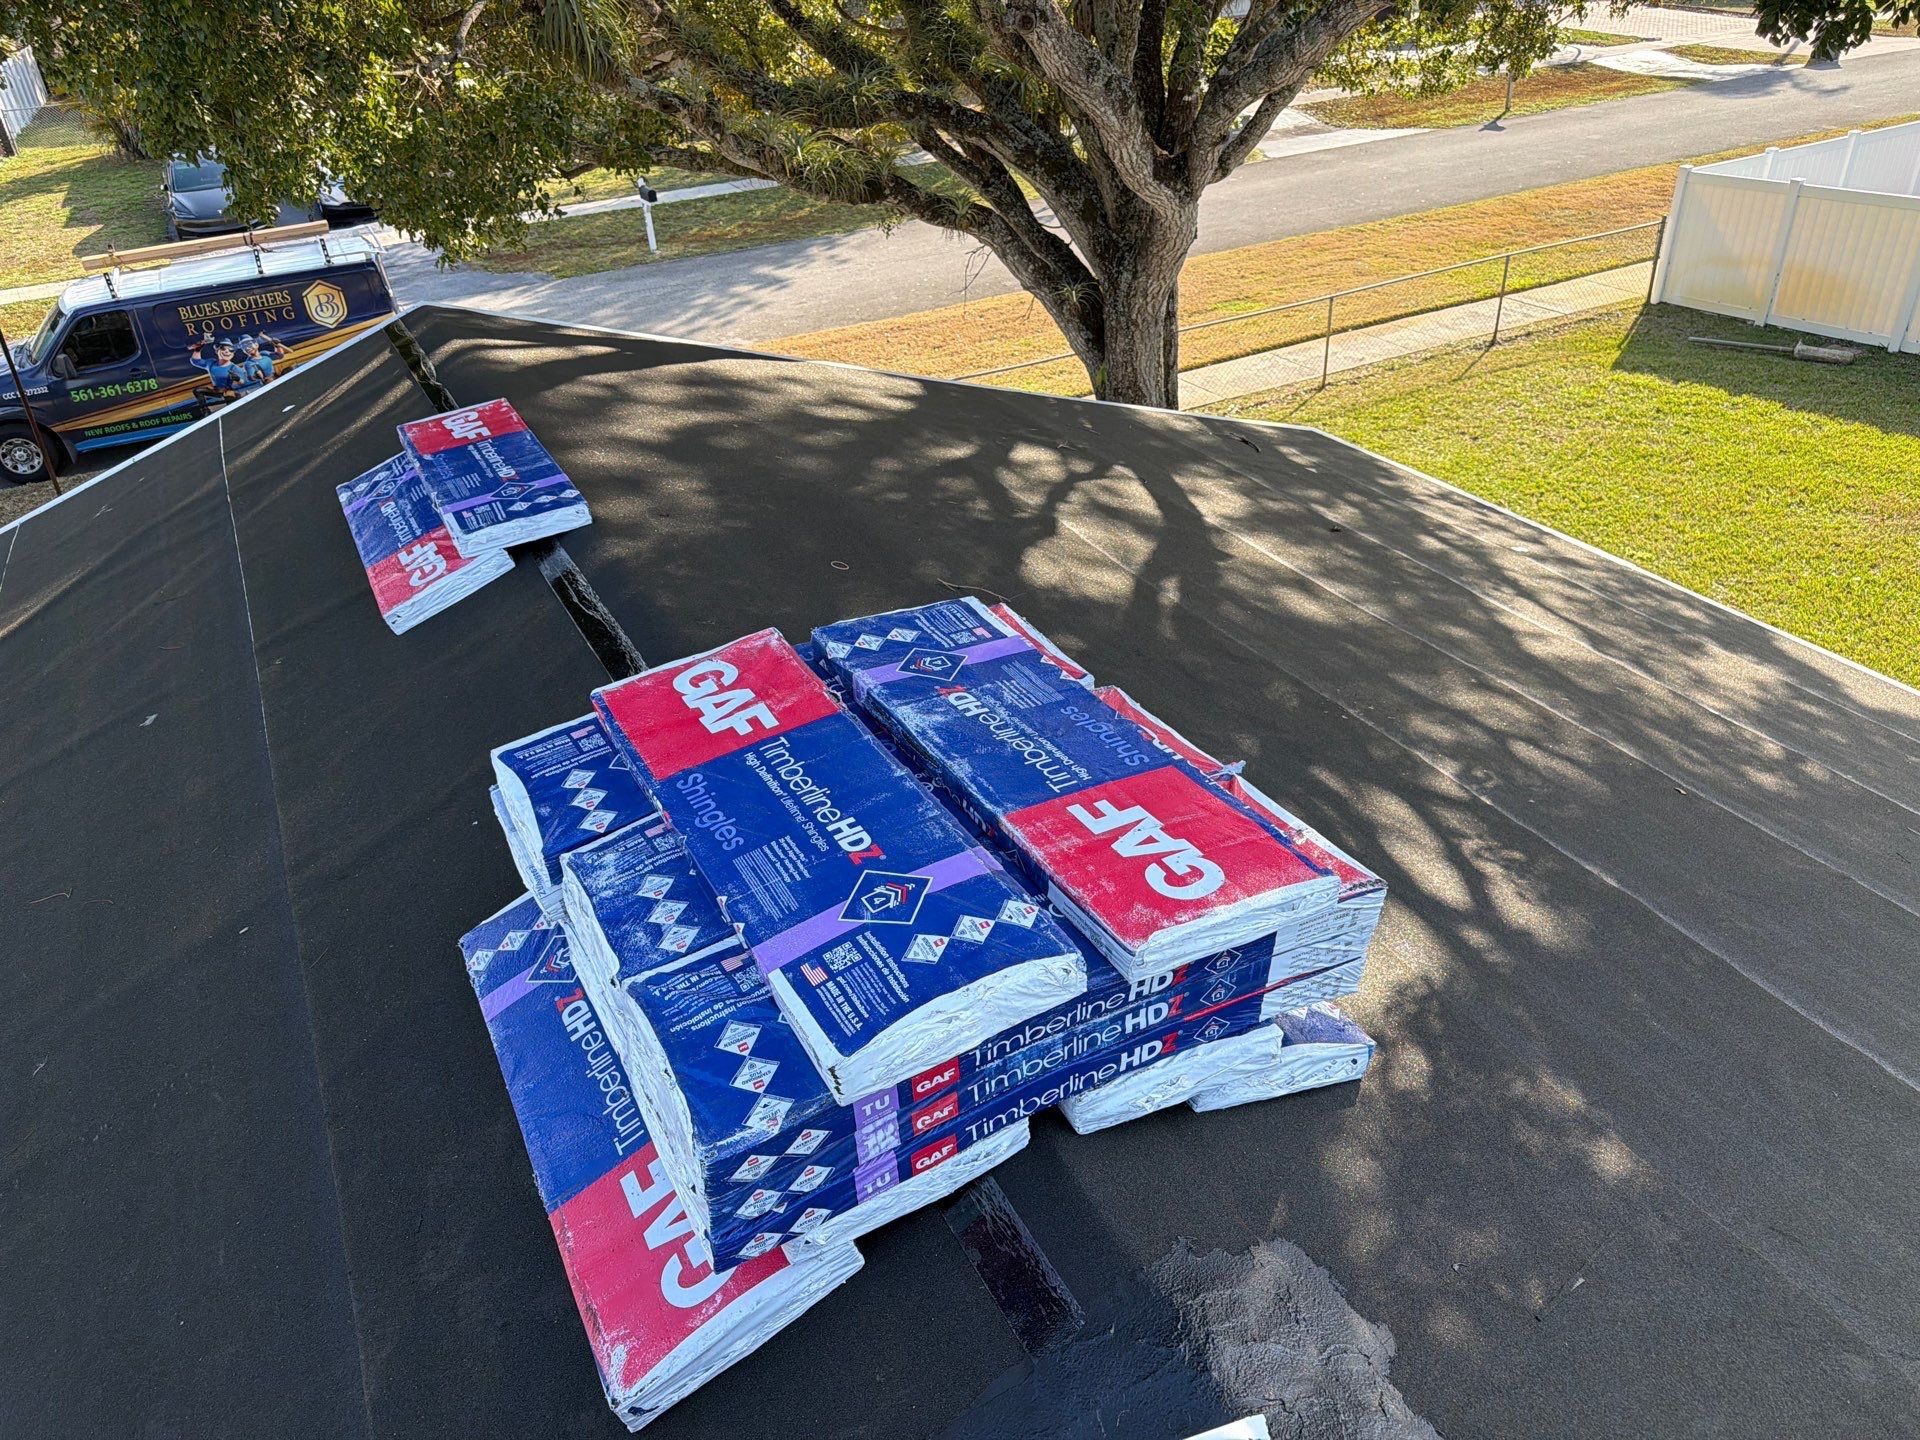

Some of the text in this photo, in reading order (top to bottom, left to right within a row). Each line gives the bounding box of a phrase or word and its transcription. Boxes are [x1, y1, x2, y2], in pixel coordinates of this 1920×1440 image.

[178, 290, 291, 320] BLUES BROTHERS
[185, 306, 295, 336] ROOFING
[2, 391, 17, 400] CCC
[70, 378, 159, 403] 561-361-6378
[84, 429, 103, 437] NEW
[105, 423, 131, 434] ROOFS
[140, 418, 160, 428] ROOF
[162, 412, 193, 424] REPAIRS
[441, 411, 492, 440] GAF
[397, 541, 447, 587] GAF
[672, 660, 780, 736] GAF
[1060, 704, 1149, 767] Shingles
[1071, 764, 1093, 781] High
[676, 772, 744, 851] Shingles
[744, 751, 761, 769] High
[801, 822, 829, 852] Shingles
[1066, 799, 1225, 900] GAF
[855, 934, 884, 969] Instrucciones
[881, 967, 890, 976] de
[886, 973, 910, 1003] instalación
[864, 930, 889, 959] Installation
[885, 956, 910, 988] instructions
[825, 980, 841, 998] MADE
[836, 995, 846, 1004] IN
[691, 1005, 737, 1031] instructions
[712, 1001, 724, 1011] de
[840, 1001, 853, 1015] THE
[670, 1007, 713, 1033] instalación
[916, 1067, 955, 1093] GAF
[861, 1094, 890, 1117] TU
[916, 1103, 954, 1129] GAF
[915, 1143, 954, 1169] GAF
[863, 1171, 891, 1194] TU
